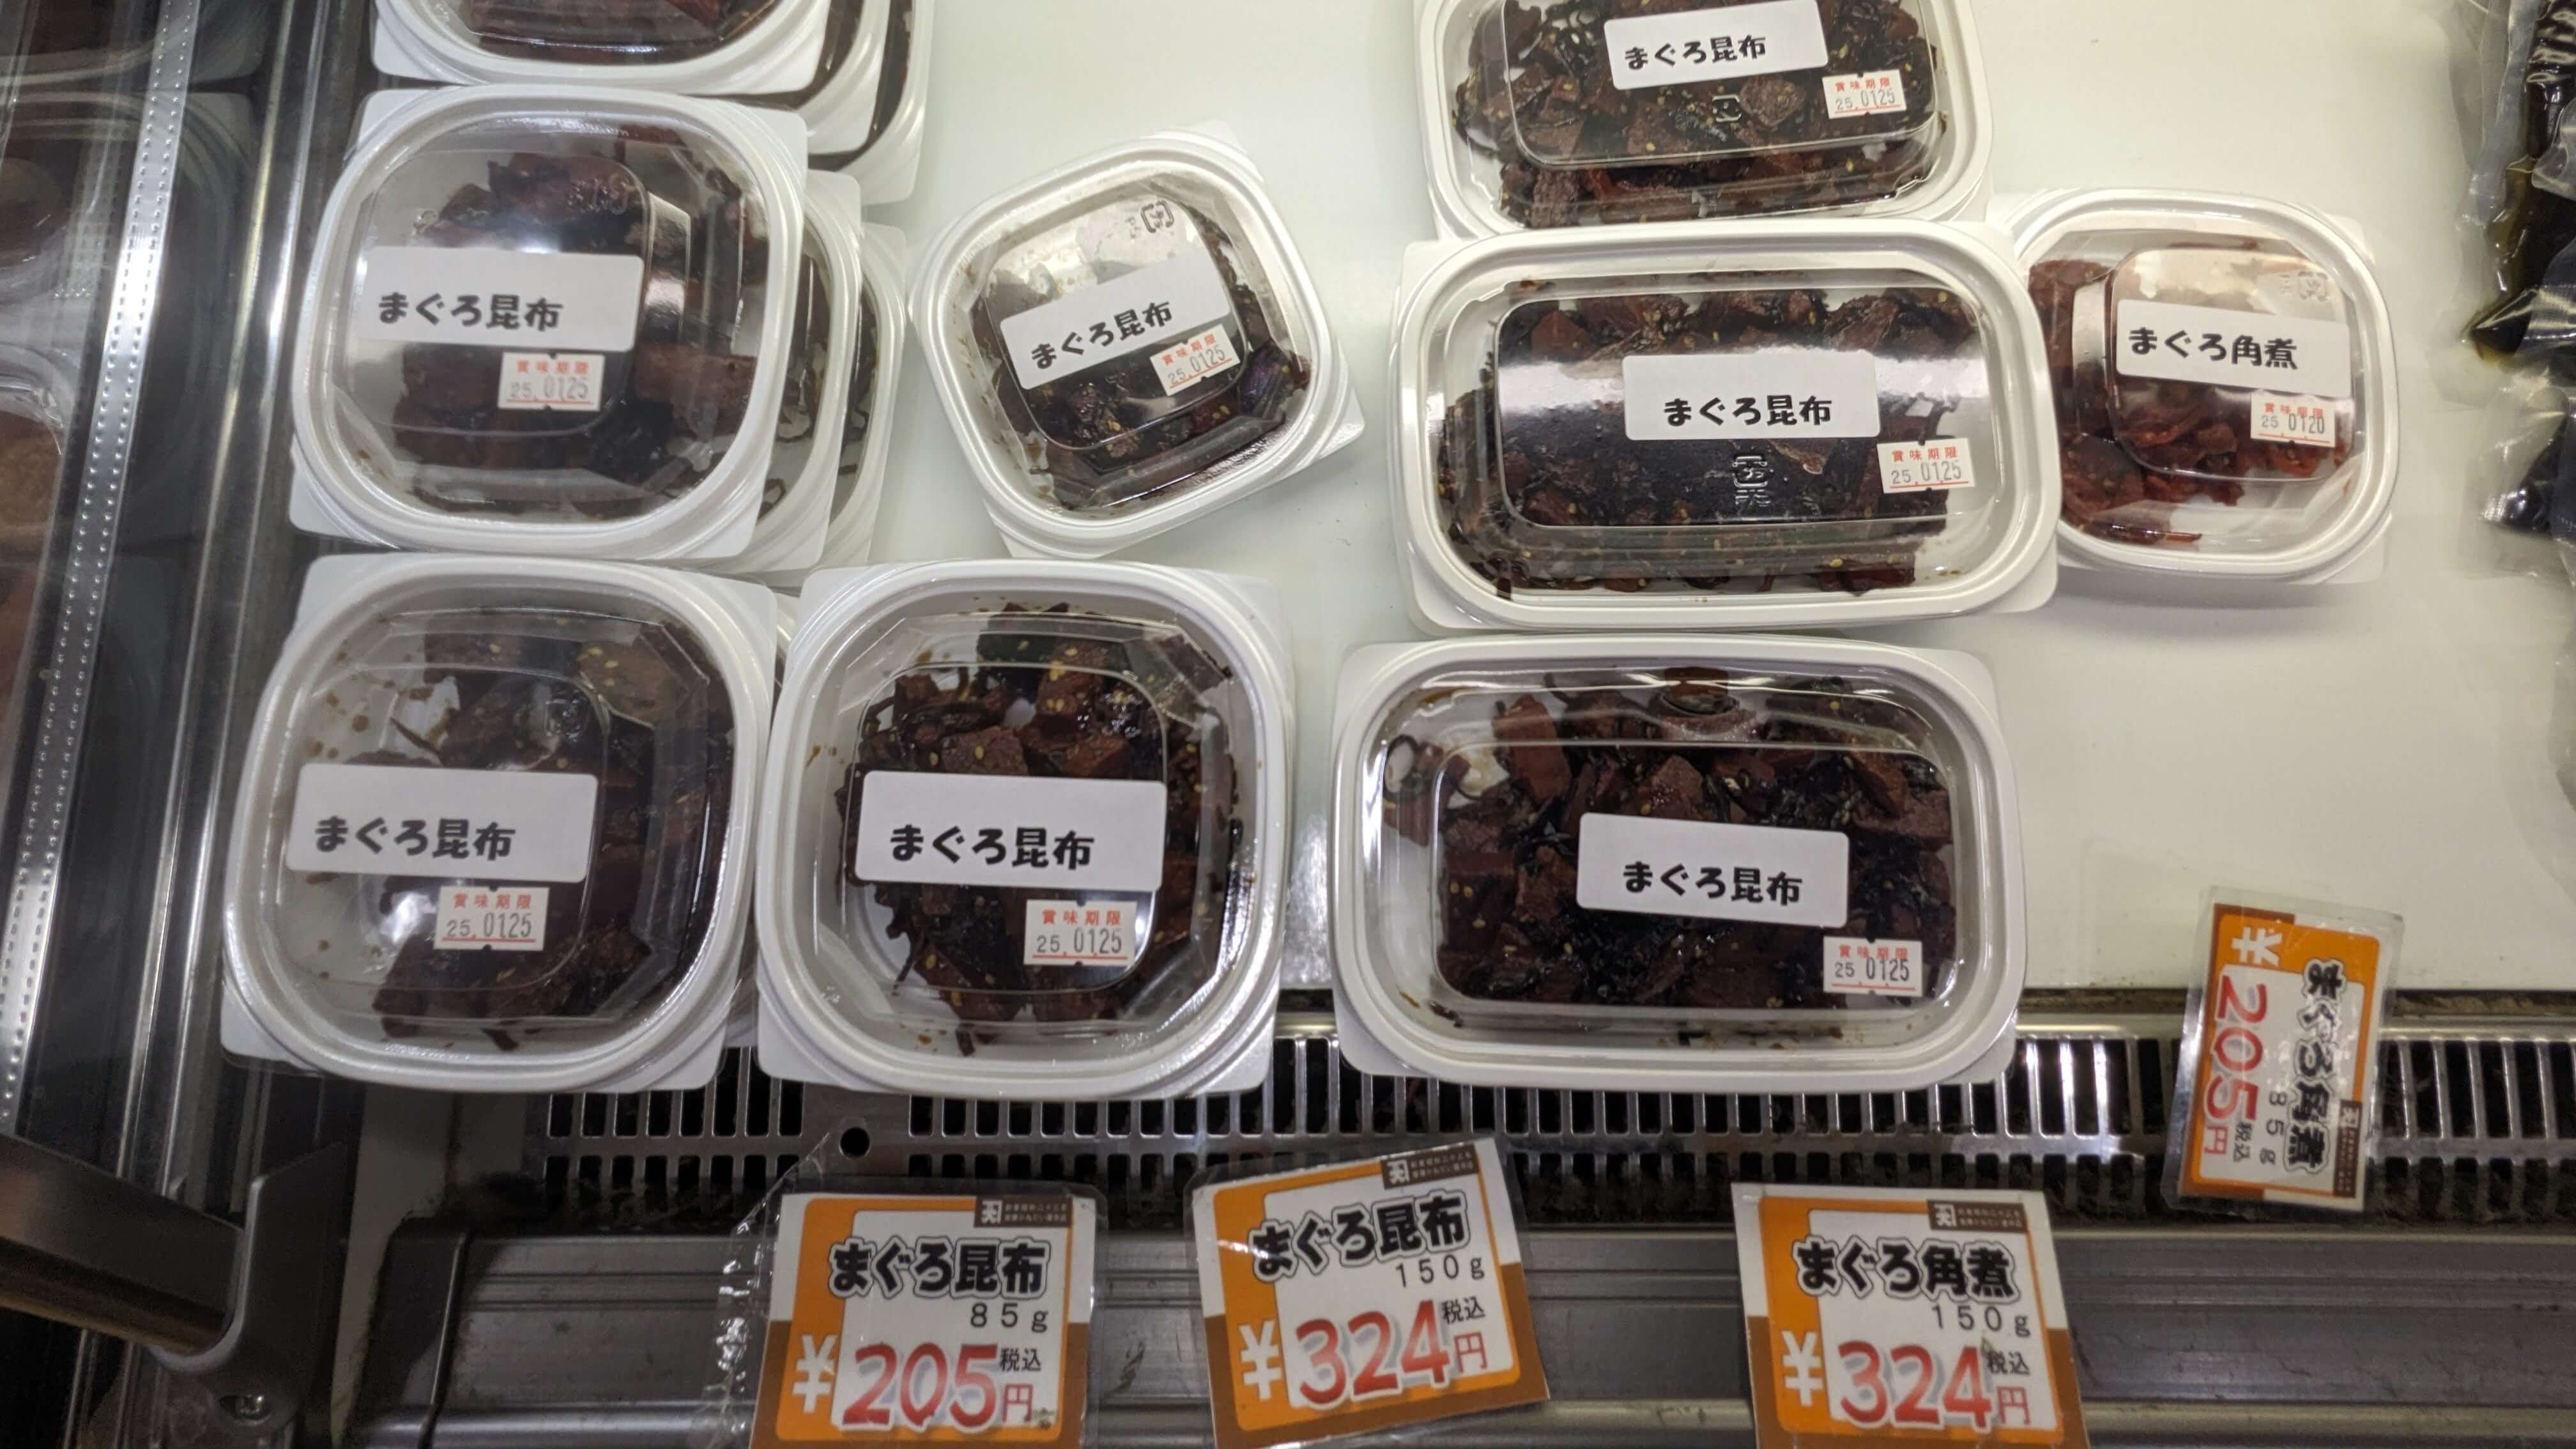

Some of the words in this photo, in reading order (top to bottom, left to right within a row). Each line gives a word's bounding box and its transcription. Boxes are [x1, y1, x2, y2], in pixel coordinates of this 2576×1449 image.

[1625, 34, 1766, 70] まぐろ昆布
[1834, 77, 1890, 91] 賞味期限
[379, 292, 563, 331] まぐろ昆布
[1031, 302, 1173, 369] まぐろ昆布
[1161, 334, 1217, 366] 賞味期限
[2129, 327, 2298, 369] まぐろ角煮
[1664, 394, 1832, 427] まぐろ昆布
[1891, 446, 1958, 461] 賞味期限
[315, 816, 516, 861] まぐろ昆布
[891, 824, 1094, 870] まぐろ昆布
[1623, 861, 1802, 905] まぐろ昆布
[453, 894, 532, 910] 賞味期限
[1043, 910, 1121, 924] 賞味期限
[1250, 1192, 1468, 1278] まぐろ昆布
[831, 1238, 1048, 1296] まぐろ昆布
[1794, 1238, 2017, 1300] まぐろ角煮
[1441, 1296, 1485, 1325] 税込
[999, 1348, 1041, 1372] 税込
[1987, 1352, 2030, 1375] 税込
